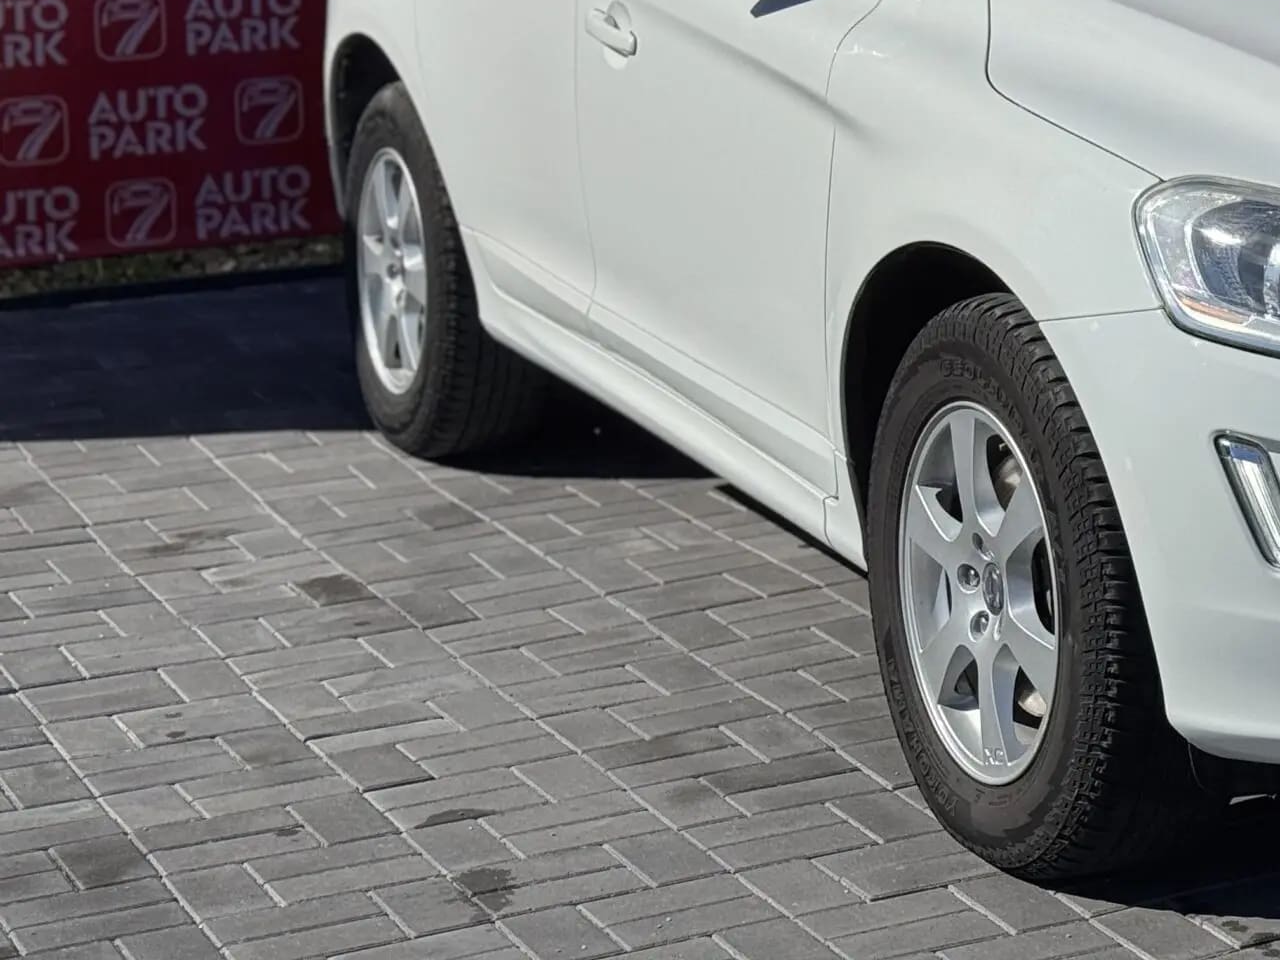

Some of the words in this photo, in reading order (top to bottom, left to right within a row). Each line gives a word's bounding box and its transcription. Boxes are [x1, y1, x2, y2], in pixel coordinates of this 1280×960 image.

[186, 15, 300, 56] PARK
[87, 84, 207, 123] AUTO
[88, 117, 206, 160] PARK
[195, 166, 311, 206] AUTO
[196, 198, 311, 240] PARK
